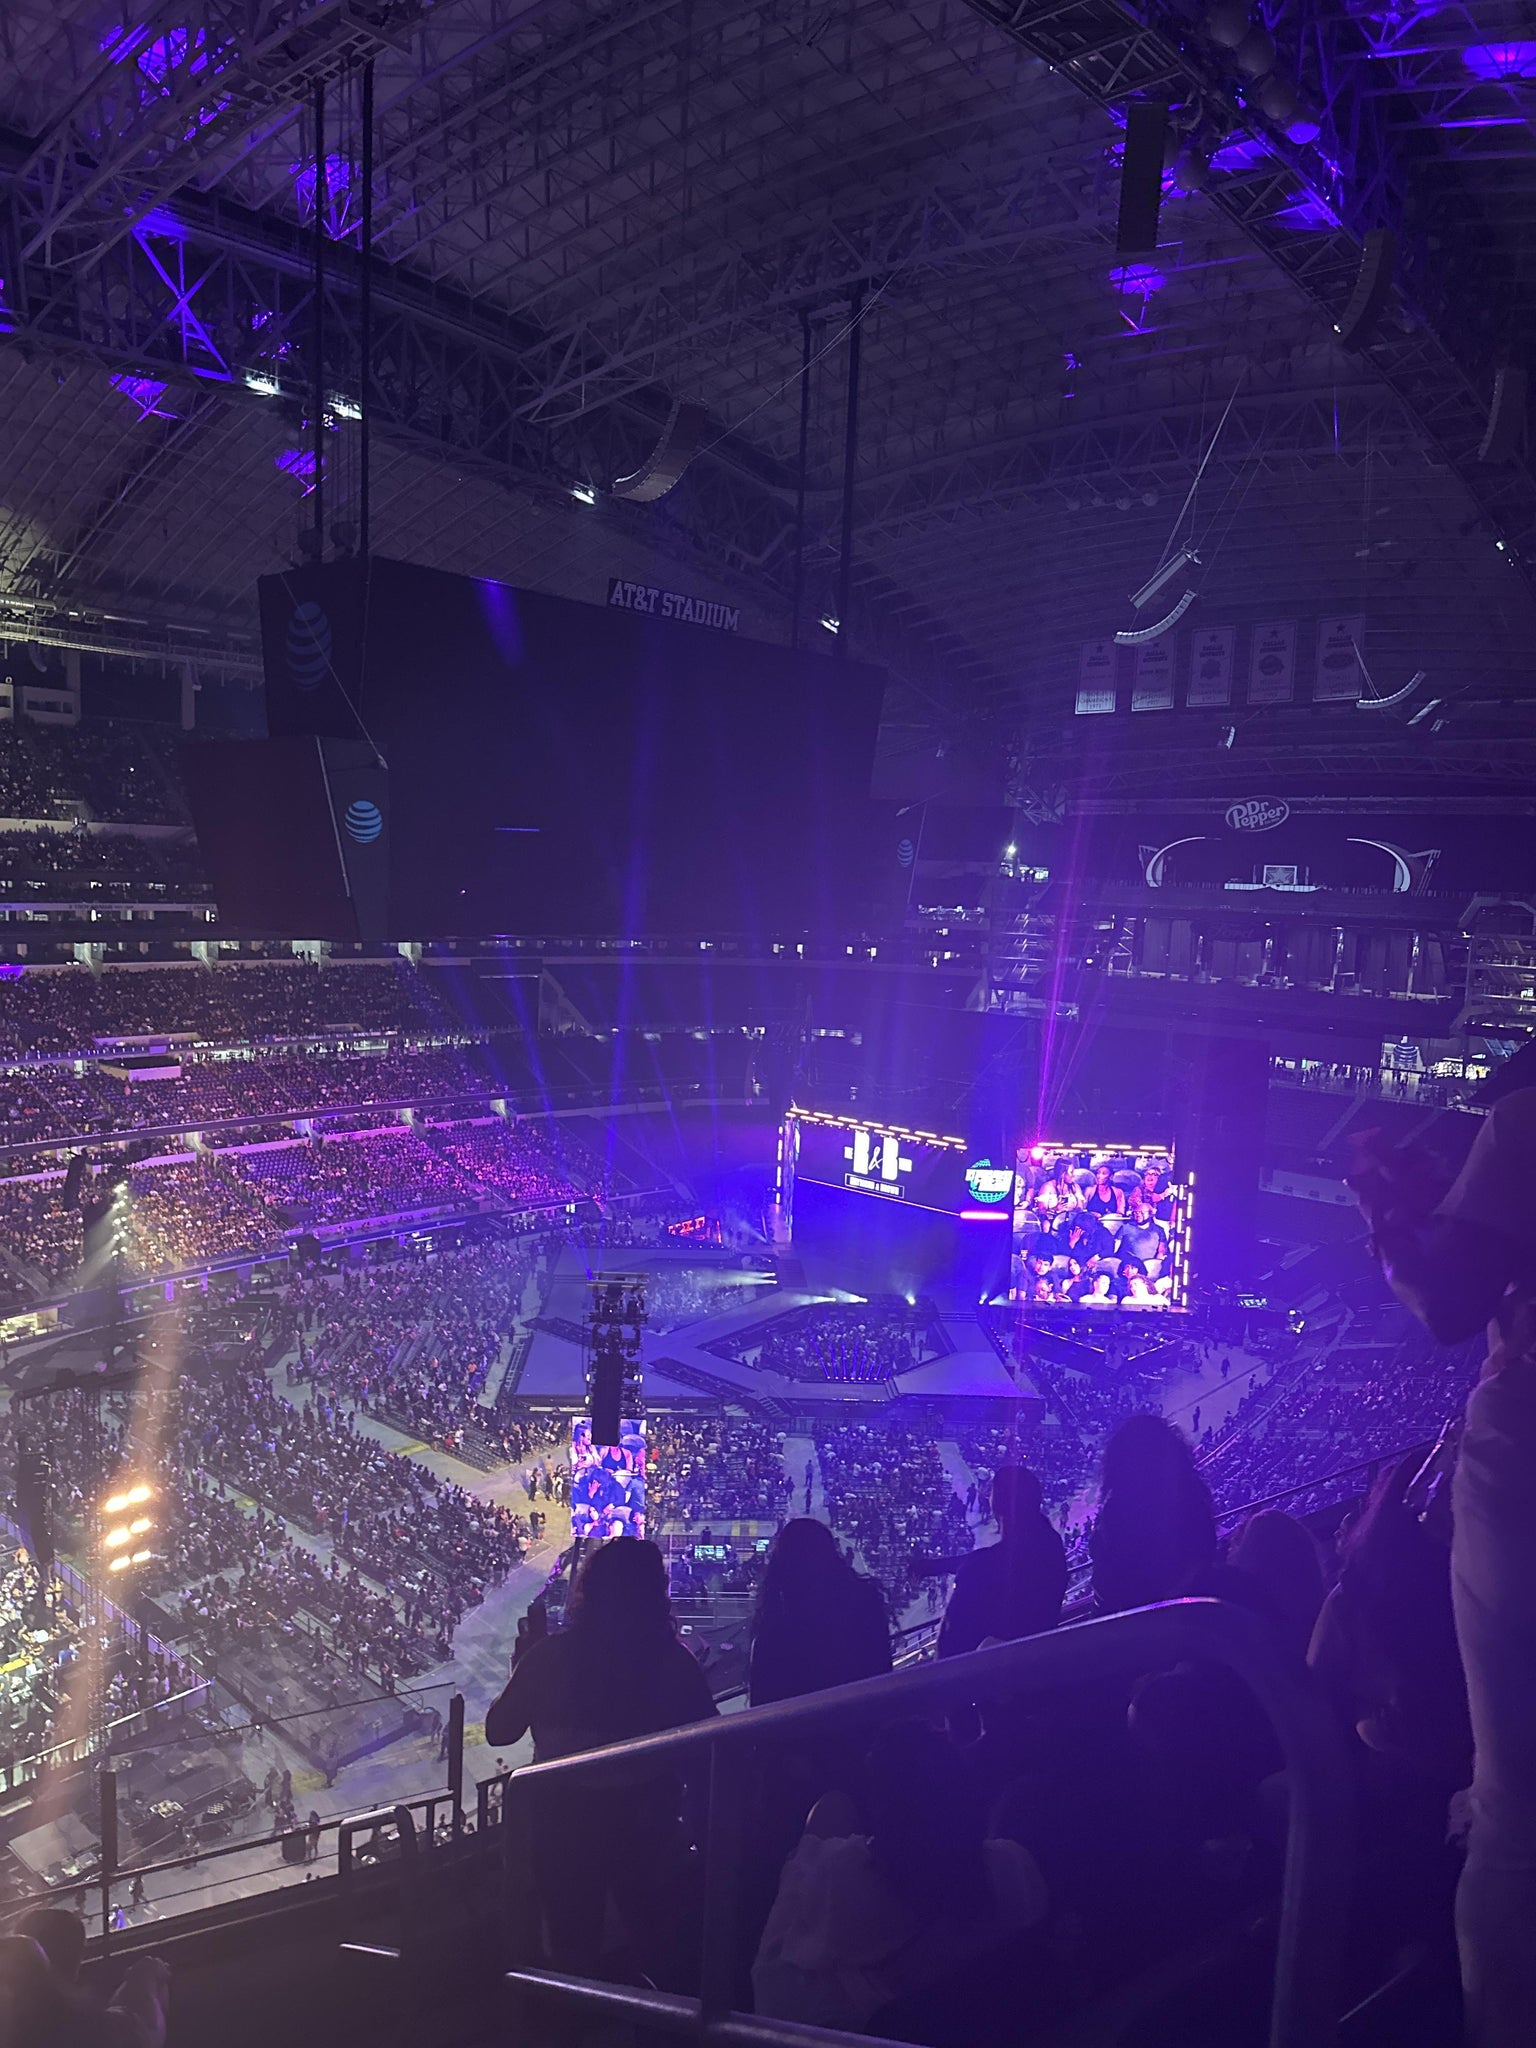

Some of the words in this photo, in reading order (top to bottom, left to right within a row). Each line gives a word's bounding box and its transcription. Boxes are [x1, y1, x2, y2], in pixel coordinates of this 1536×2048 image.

[610, 580, 660, 613] AT&T
[661, 592, 740, 632] STADIUM
[1231, 804, 1285, 829] Pepper
[1246, 800, 1269, 816] Dr
